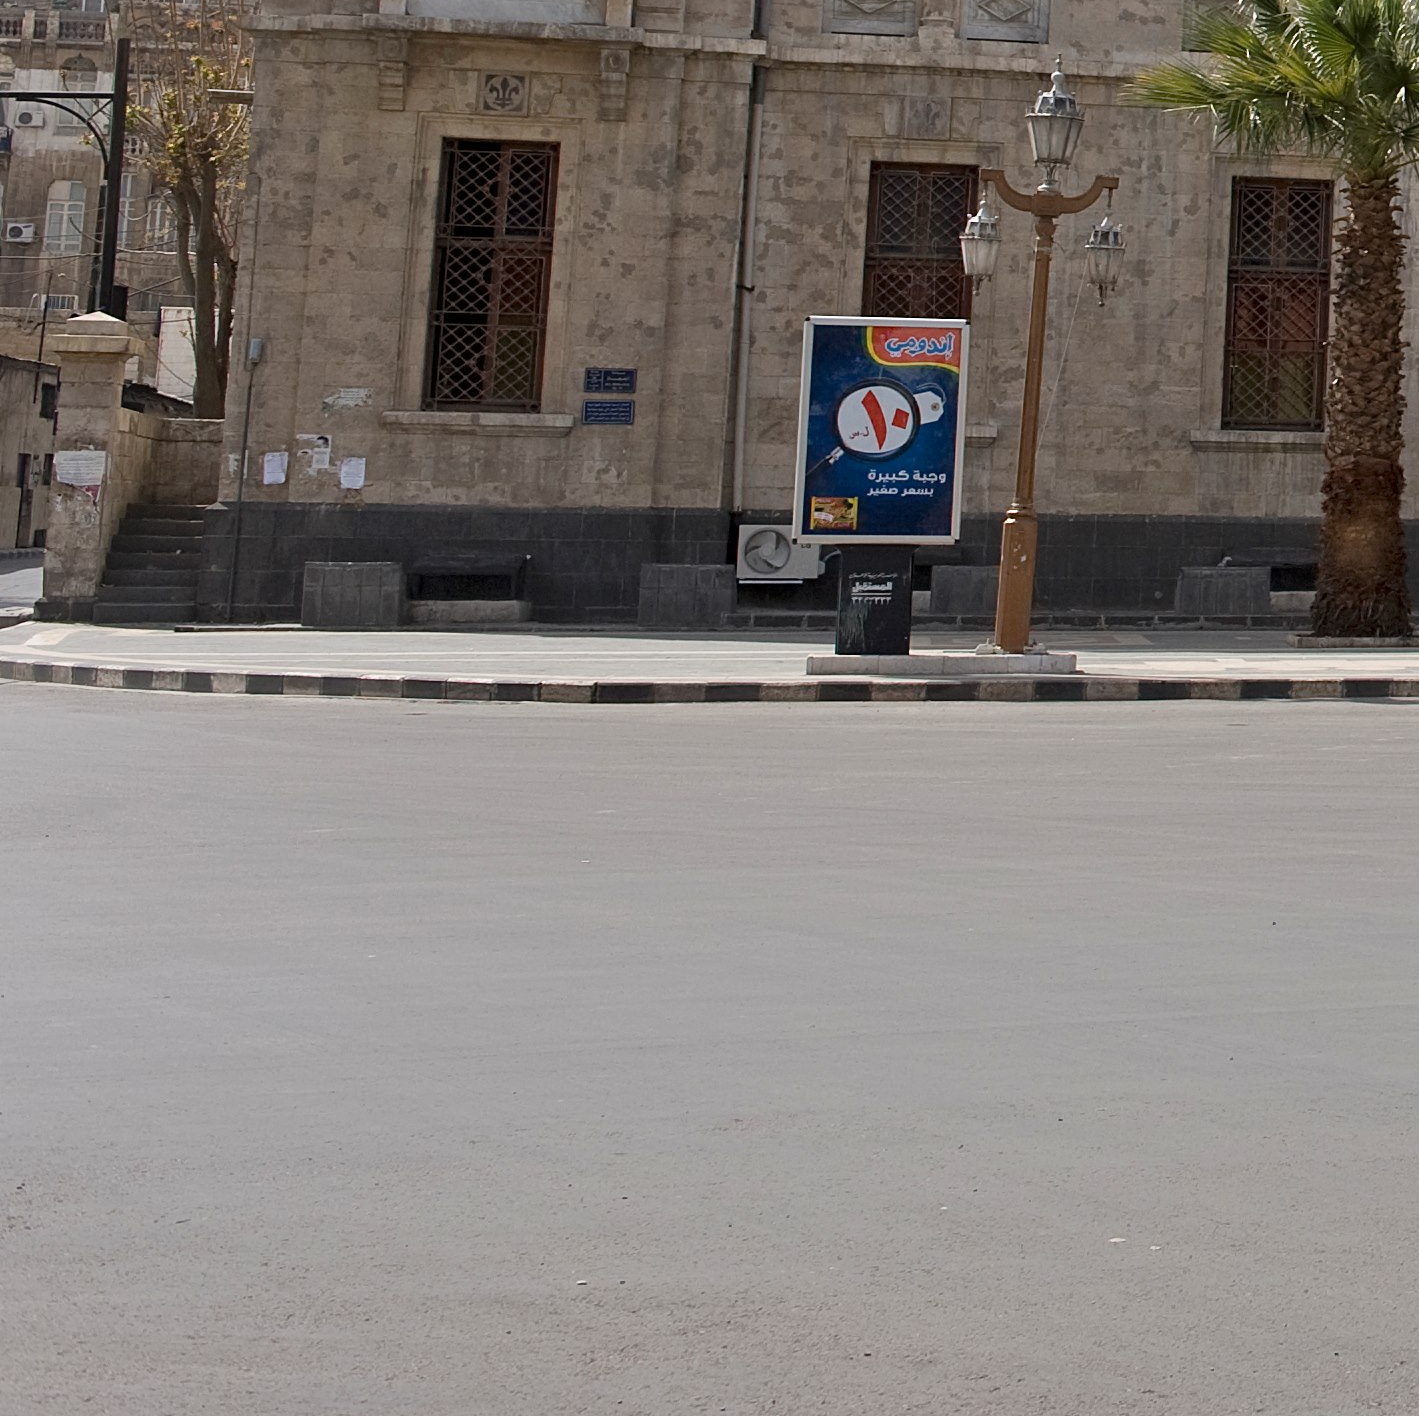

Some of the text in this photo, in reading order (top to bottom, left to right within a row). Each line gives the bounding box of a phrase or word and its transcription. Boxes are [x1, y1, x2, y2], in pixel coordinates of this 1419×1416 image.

[885, 333, 955, 360] إندومي
[861, 390, 910, 451] ١٠
[868, 469, 946, 483] وجبة كبيرة
[867, 485, 934, 497] بسعر صغير
